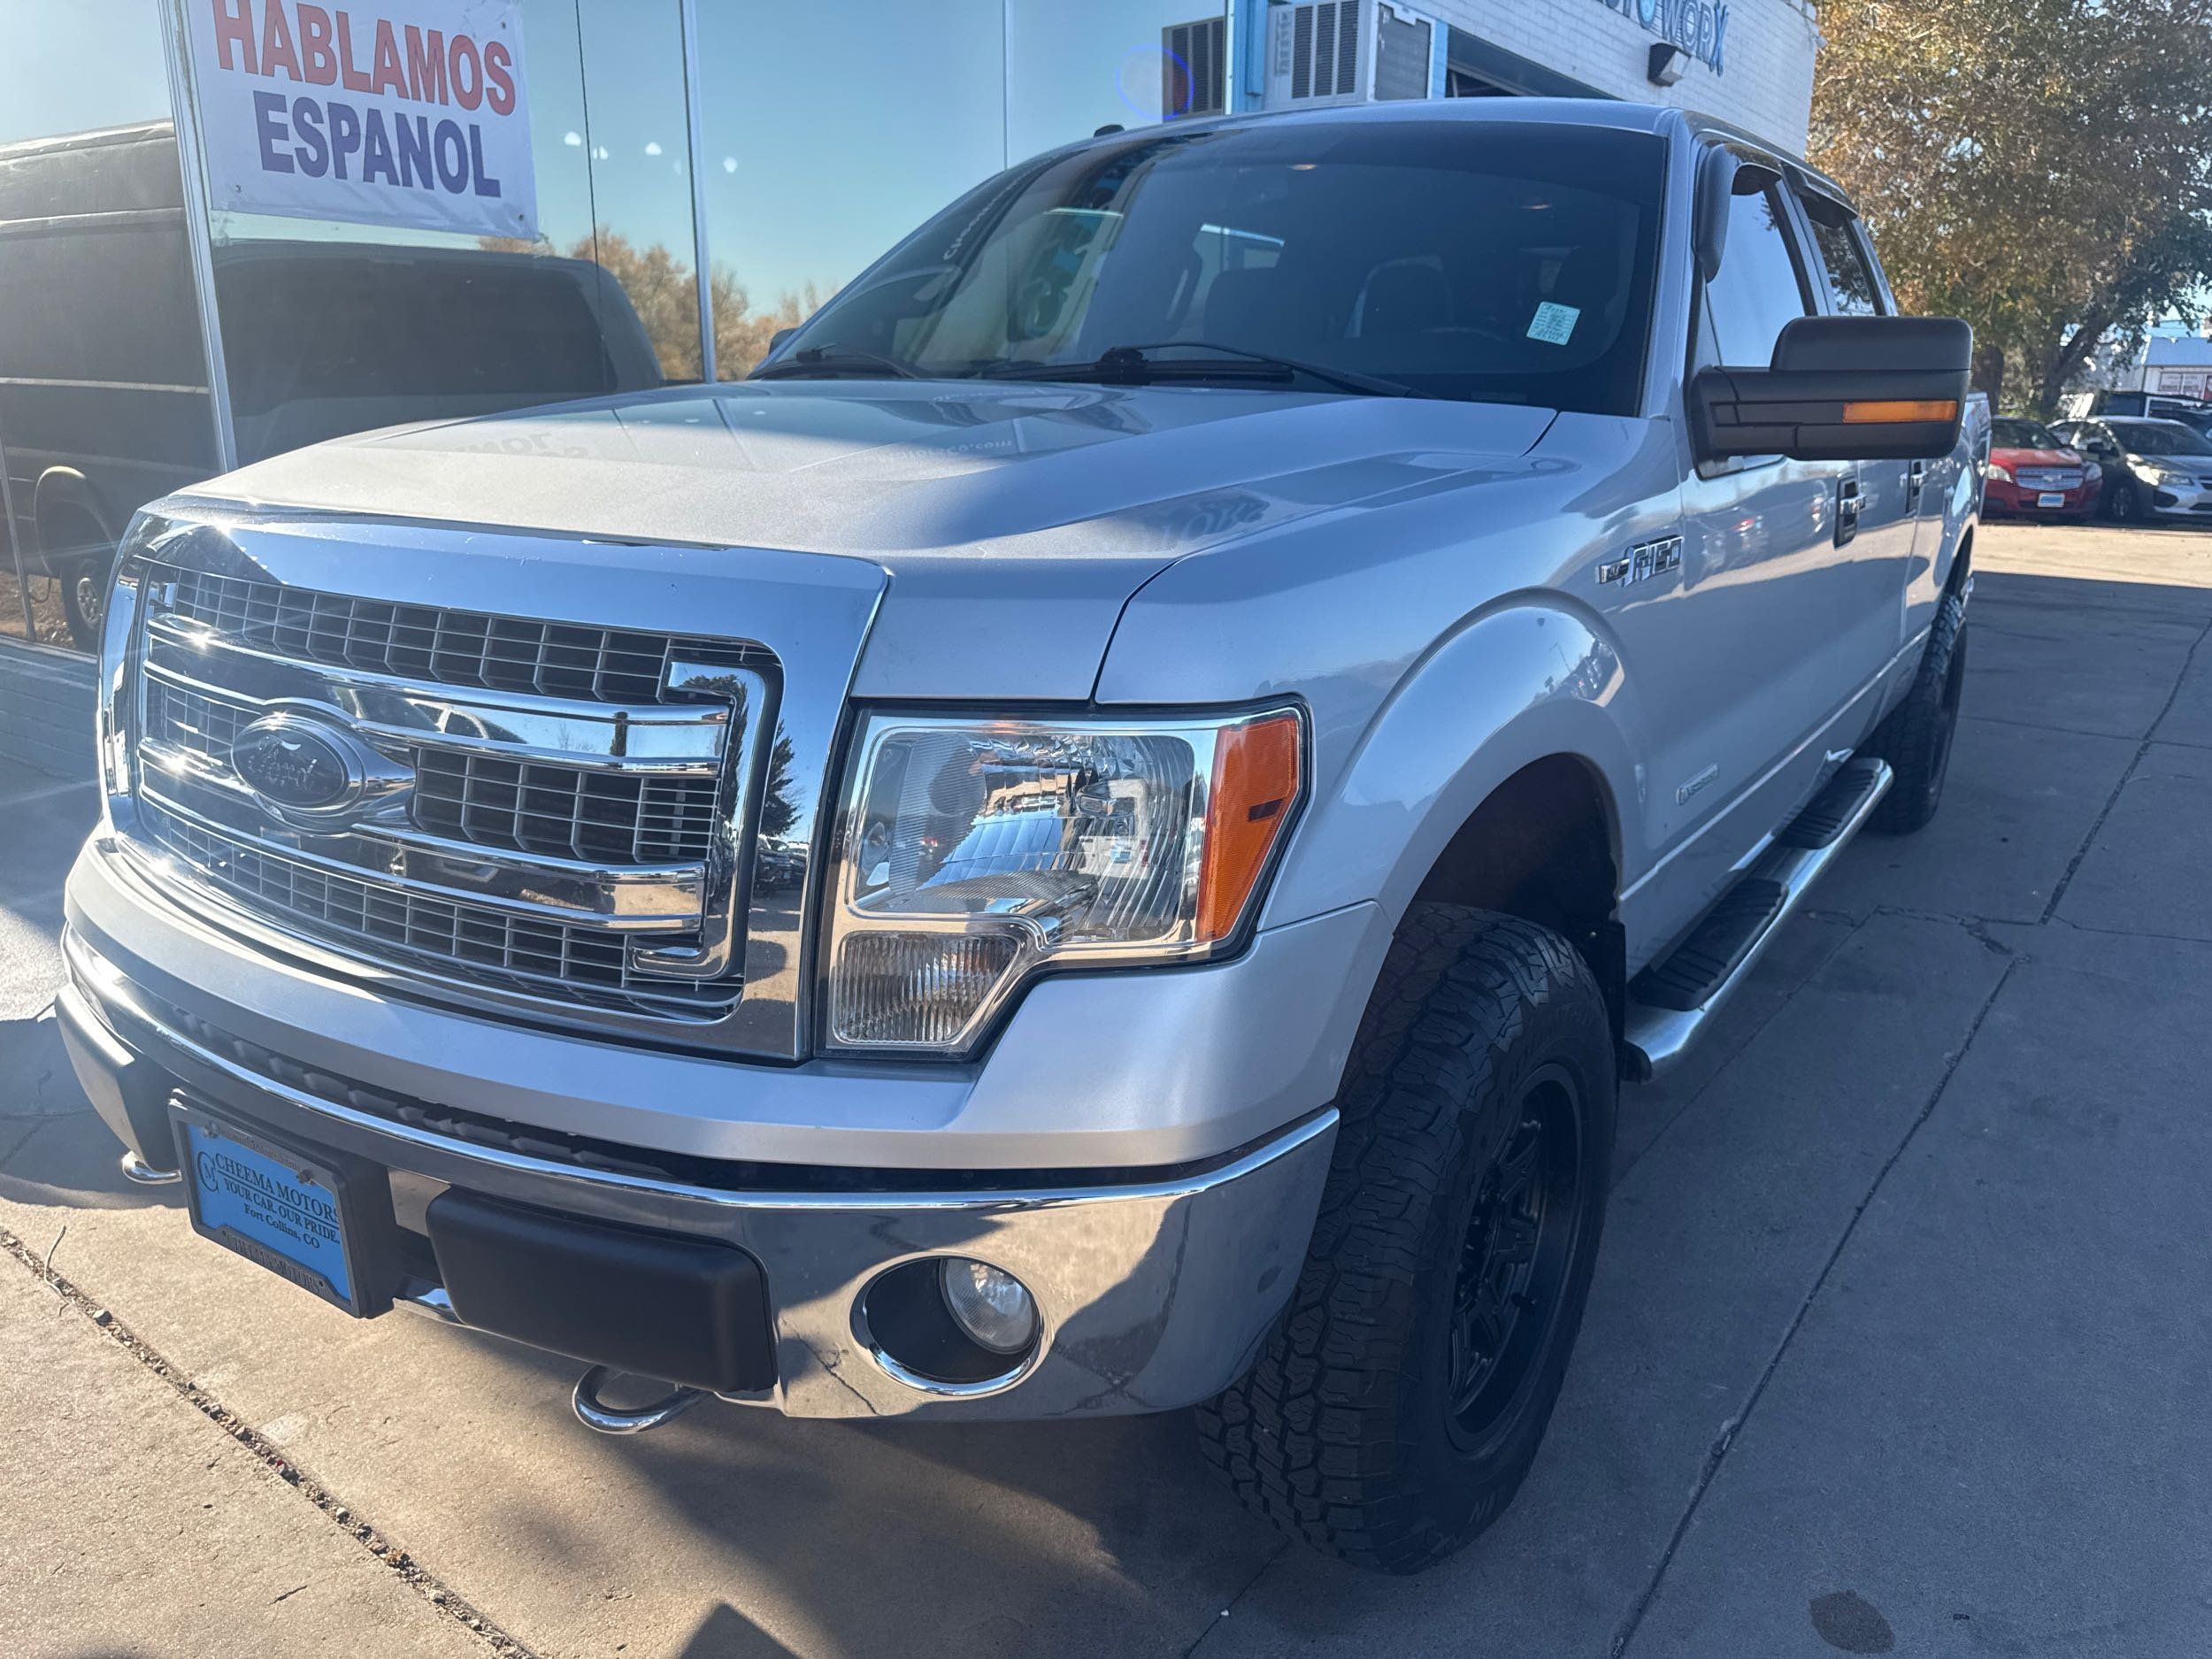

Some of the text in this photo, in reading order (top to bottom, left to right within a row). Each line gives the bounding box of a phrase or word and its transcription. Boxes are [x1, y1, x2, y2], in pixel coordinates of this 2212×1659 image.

[212, 0, 516, 116] HABLAMOS
[253, 90, 501, 198] ESPANOL
[215, 1153, 274, 1194] CHEEMA
[224, 1178, 253, 1202] YOUR
[253, 1193, 277, 1213] CAR.
[279, 1206, 303, 1227] OUR
[244, 1203, 320, 1248] Fort Collins, CO
